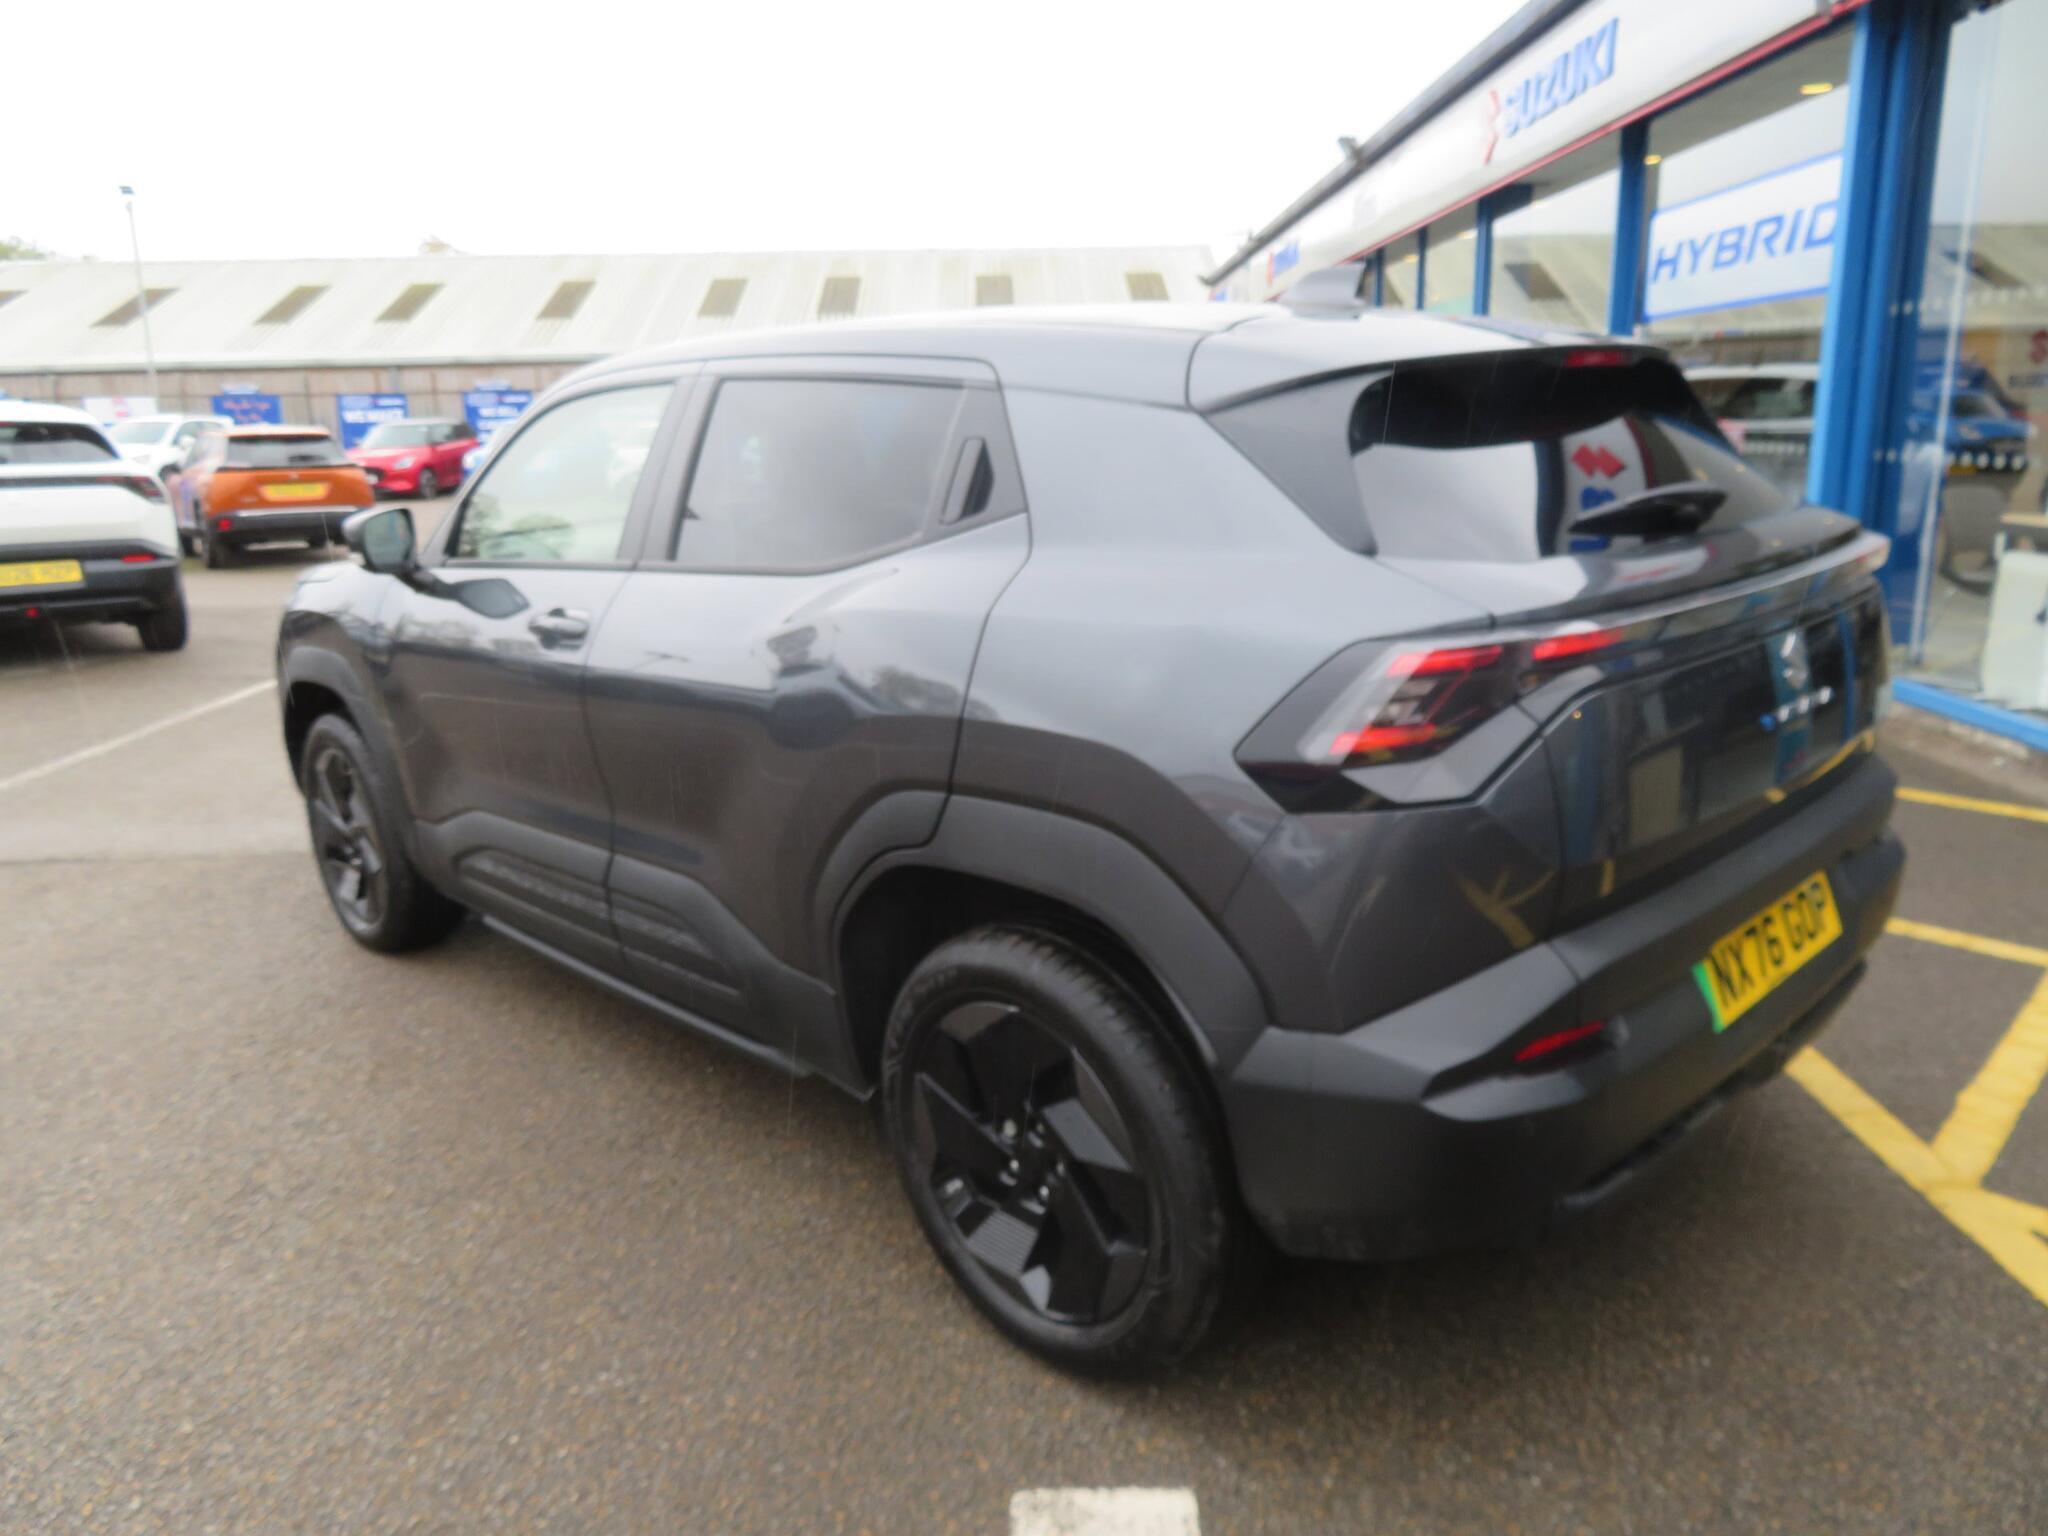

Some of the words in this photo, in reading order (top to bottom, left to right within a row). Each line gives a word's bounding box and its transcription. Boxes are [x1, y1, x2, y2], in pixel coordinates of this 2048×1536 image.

[1505, 16, 1619, 139] SUZUKI
[1651, 201, 1838, 284] HYBRID
[1710, 914, 1785, 1009] NX76
